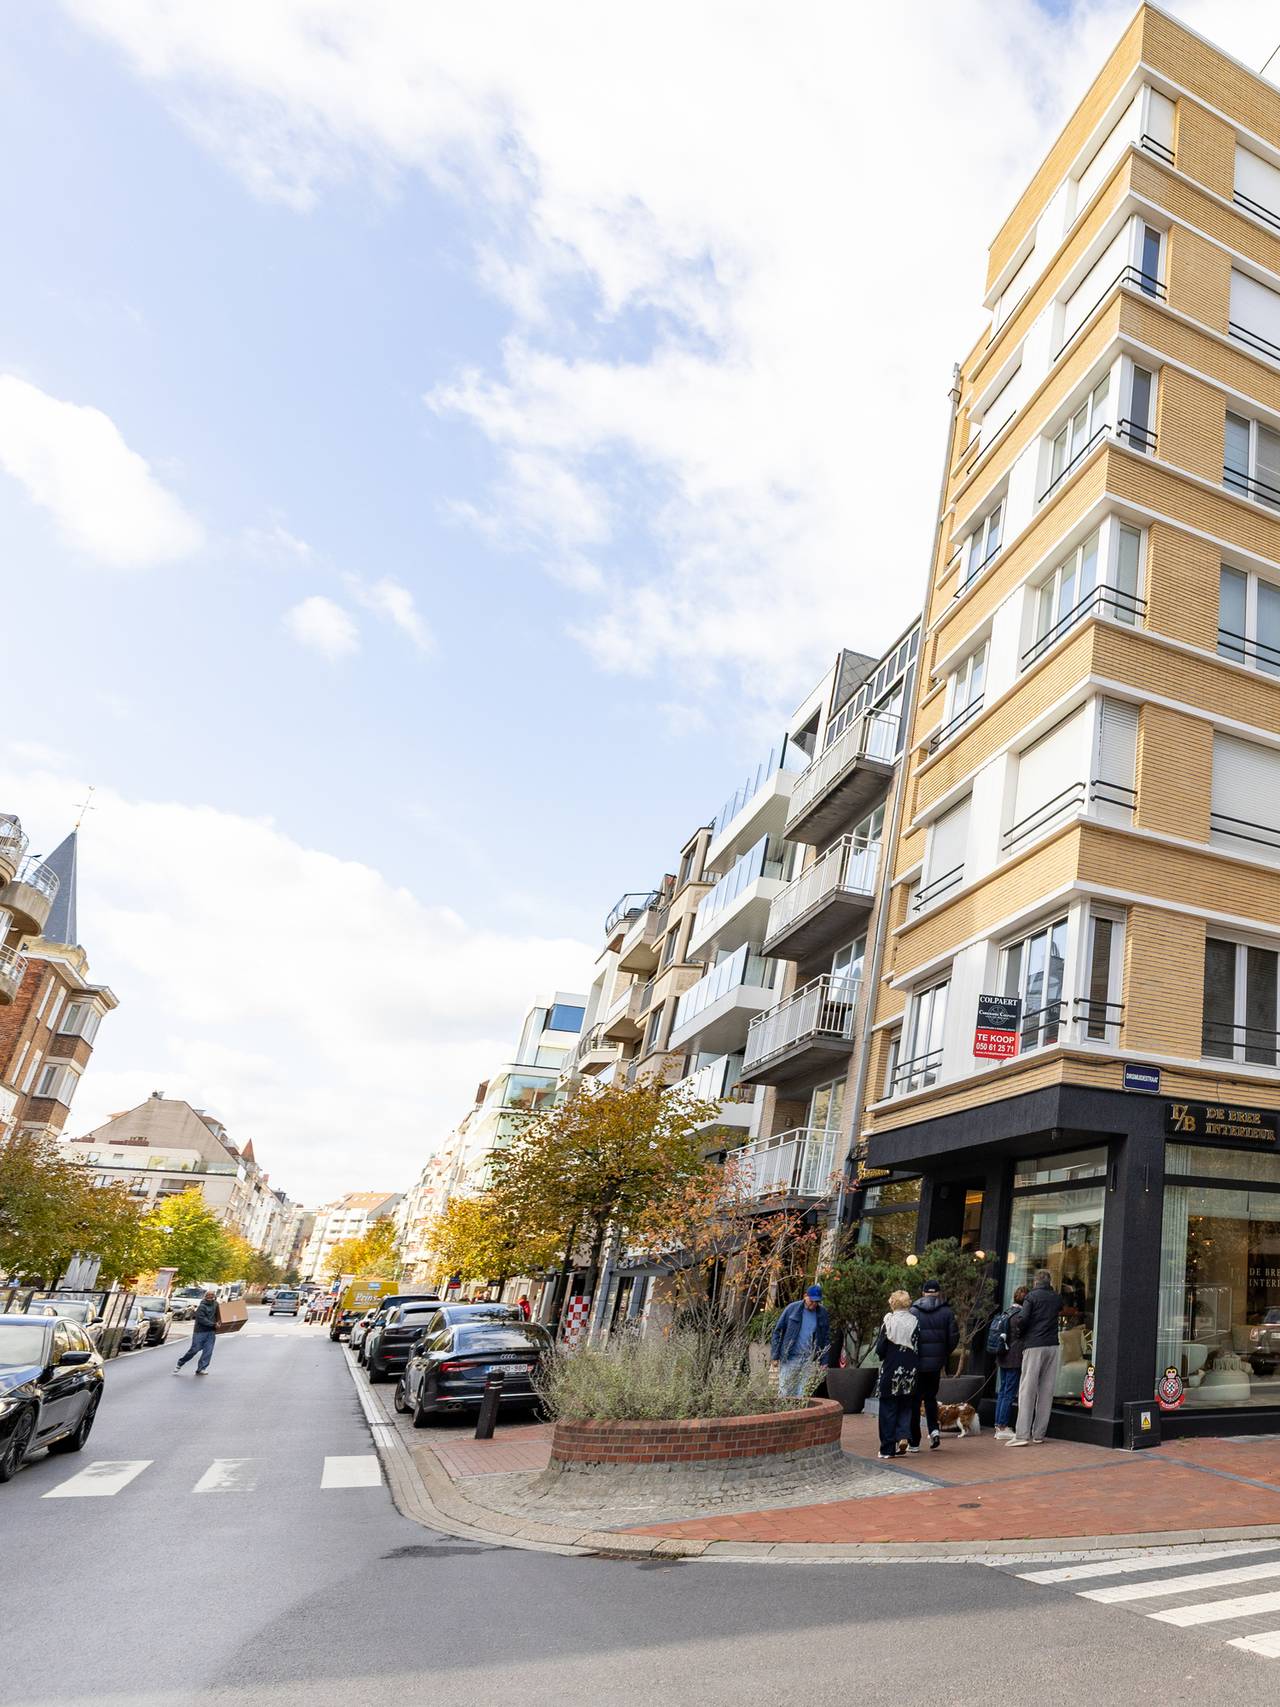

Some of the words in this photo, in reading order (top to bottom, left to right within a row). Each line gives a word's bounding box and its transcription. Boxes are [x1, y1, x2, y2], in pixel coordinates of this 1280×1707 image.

[980, 996, 1018, 1006] COLPAERT
[977, 1033, 989, 1042] TE
[990, 1035, 1015, 1043] KOOP
[998, 1044, 1006, 1052] 25
[1205, 1107, 1225, 1120] DE
[1228, 1110, 1261, 1124] BREE
[1205, 1122, 1276, 1141] INTERIEUR
